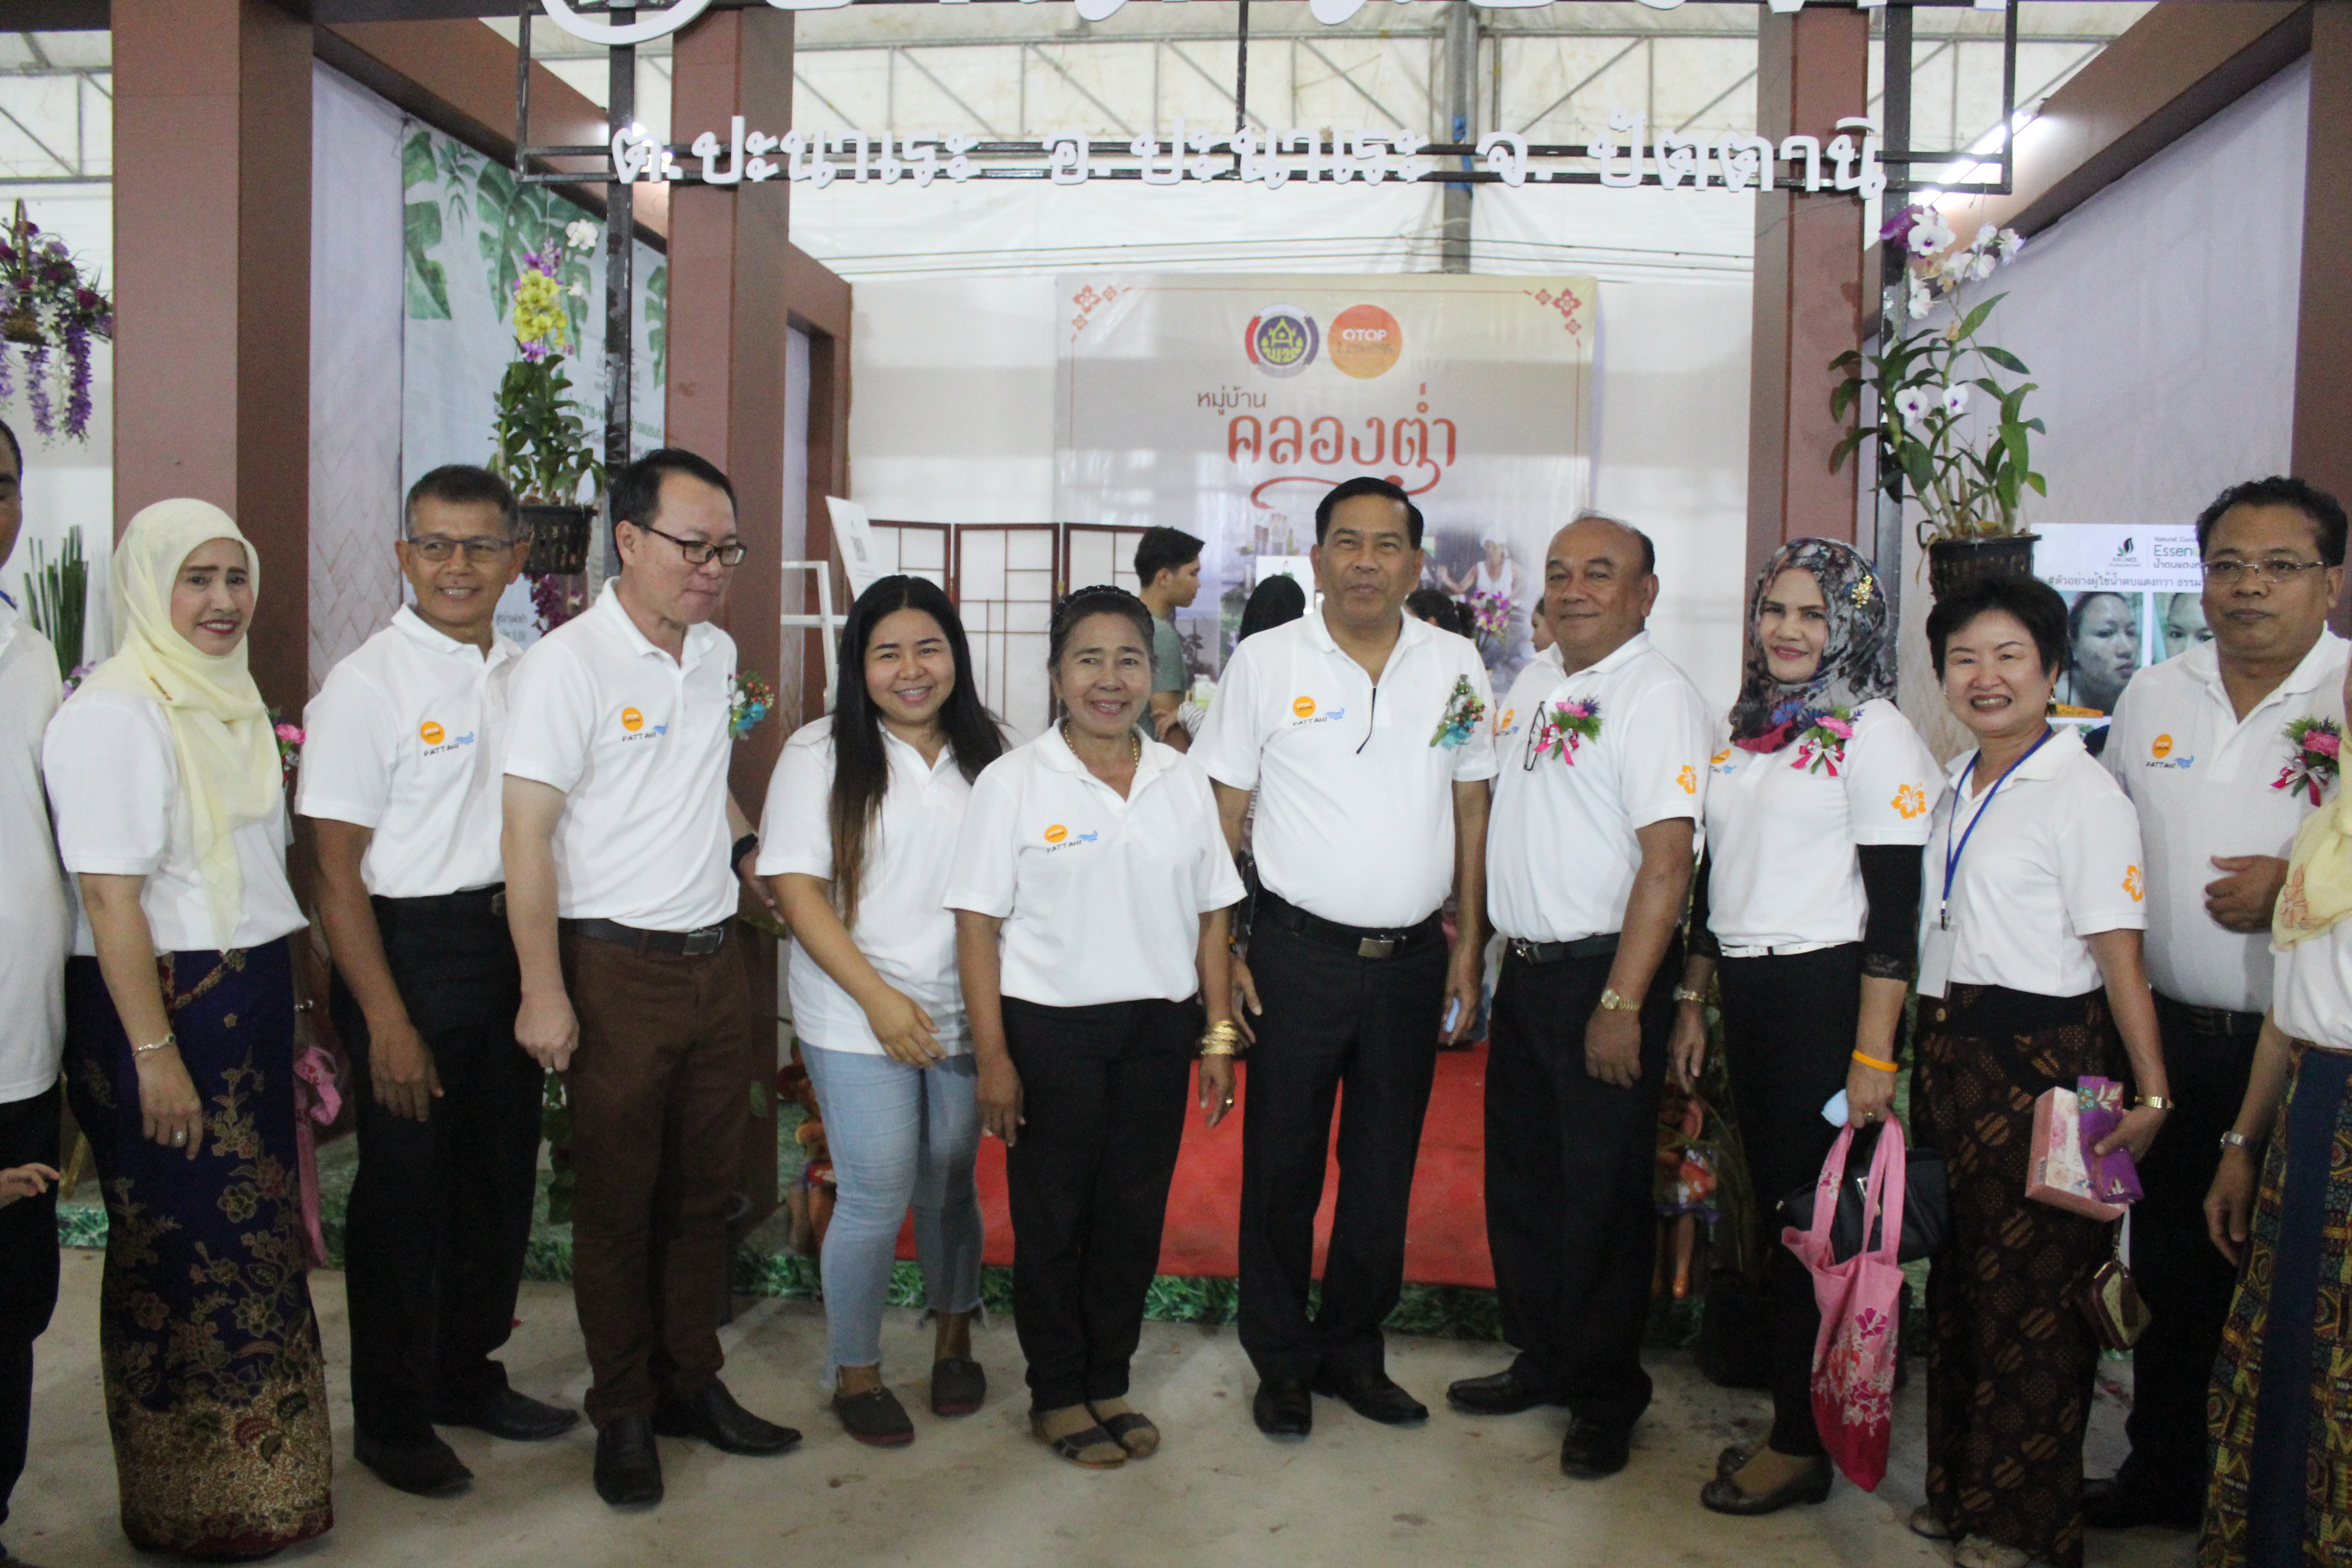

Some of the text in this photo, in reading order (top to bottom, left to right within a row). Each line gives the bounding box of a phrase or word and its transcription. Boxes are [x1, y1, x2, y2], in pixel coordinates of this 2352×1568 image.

[1342, 329, 1388, 341] OTOP
[1197, 385, 1267, 415] หมู่บ้าน
[1293, 717, 1327, 726] PATTANI
[622, 731, 657, 742] PATTANI
[424, 743, 459, 757] PATTANI
[1046, 839, 1082, 853] PATTANI
